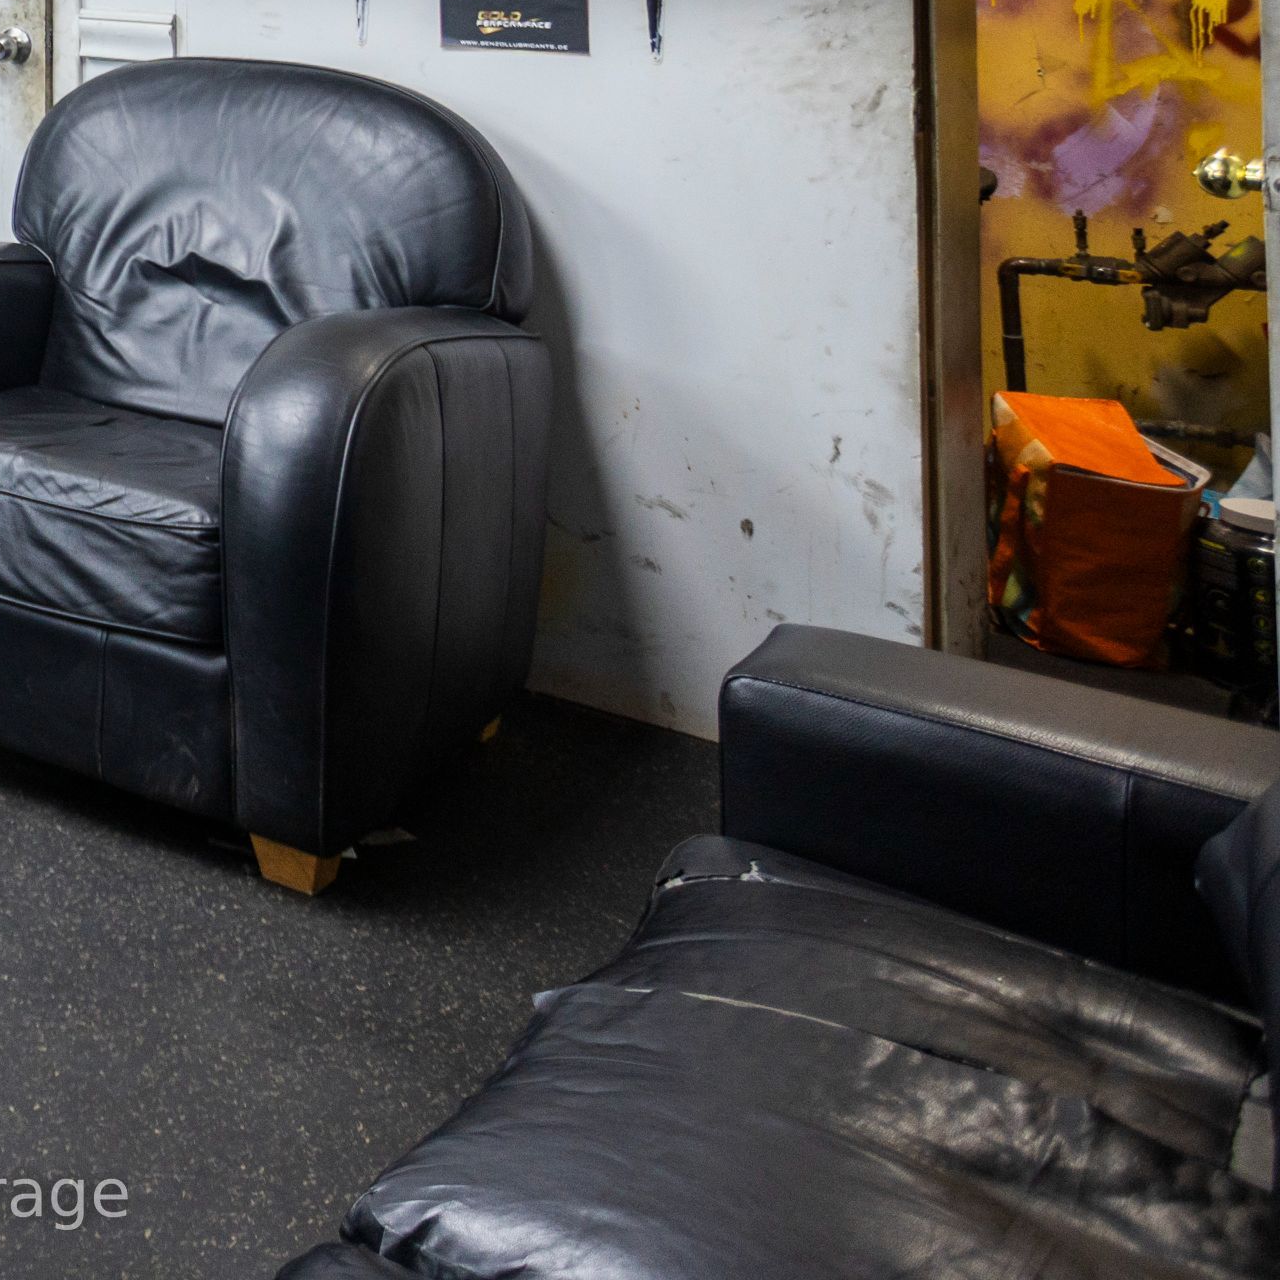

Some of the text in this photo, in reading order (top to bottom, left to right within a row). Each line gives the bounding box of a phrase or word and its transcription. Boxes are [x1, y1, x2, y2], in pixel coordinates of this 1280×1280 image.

[477, 10, 522, 21] GOLD
[476, 19, 552, 30] PERFORMANCE
[460, 39, 569, 51] WWW.BENZOLLUBRICANTS.DE
